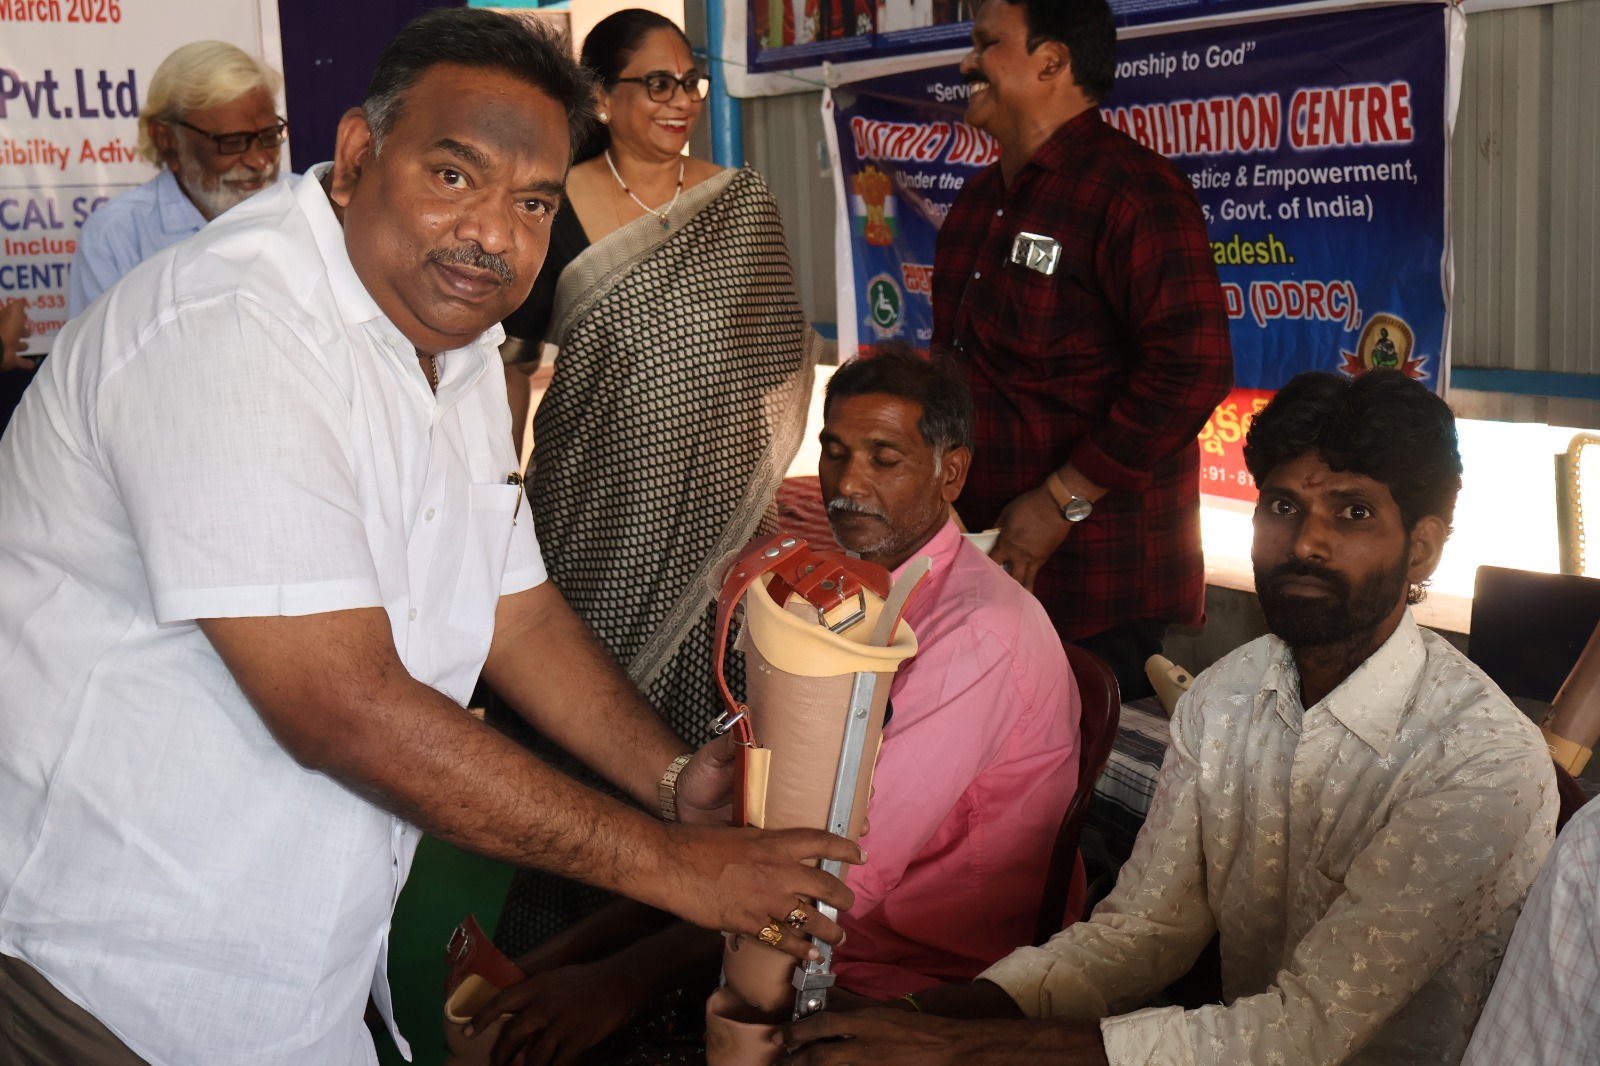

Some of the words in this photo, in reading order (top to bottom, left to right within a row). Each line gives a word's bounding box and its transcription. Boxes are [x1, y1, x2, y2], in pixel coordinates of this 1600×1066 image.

[68, 0, 121, 24] 2026
[1115, 53, 1176, 79] orship
[1182, 51, 1199, 72] to
[851, 116, 951, 162] DISTRICT
[1287, 79, 1415, 148] CENTRE
[939, 172, 964, 190] the
[1187, 167, 1231, 189] stice
[1235, 165, 1248, 187] &
[1253, 159, 1417, 191] Empowerment,
[1220, 198, 1272, 221] Govt.
[1278, 197, 1300, 219] of
[1306, 194, 1373, 222] India)
[1210, 233, 1294, 265] adesh.
[1250, 280, 1363, 333] (DDRC),
